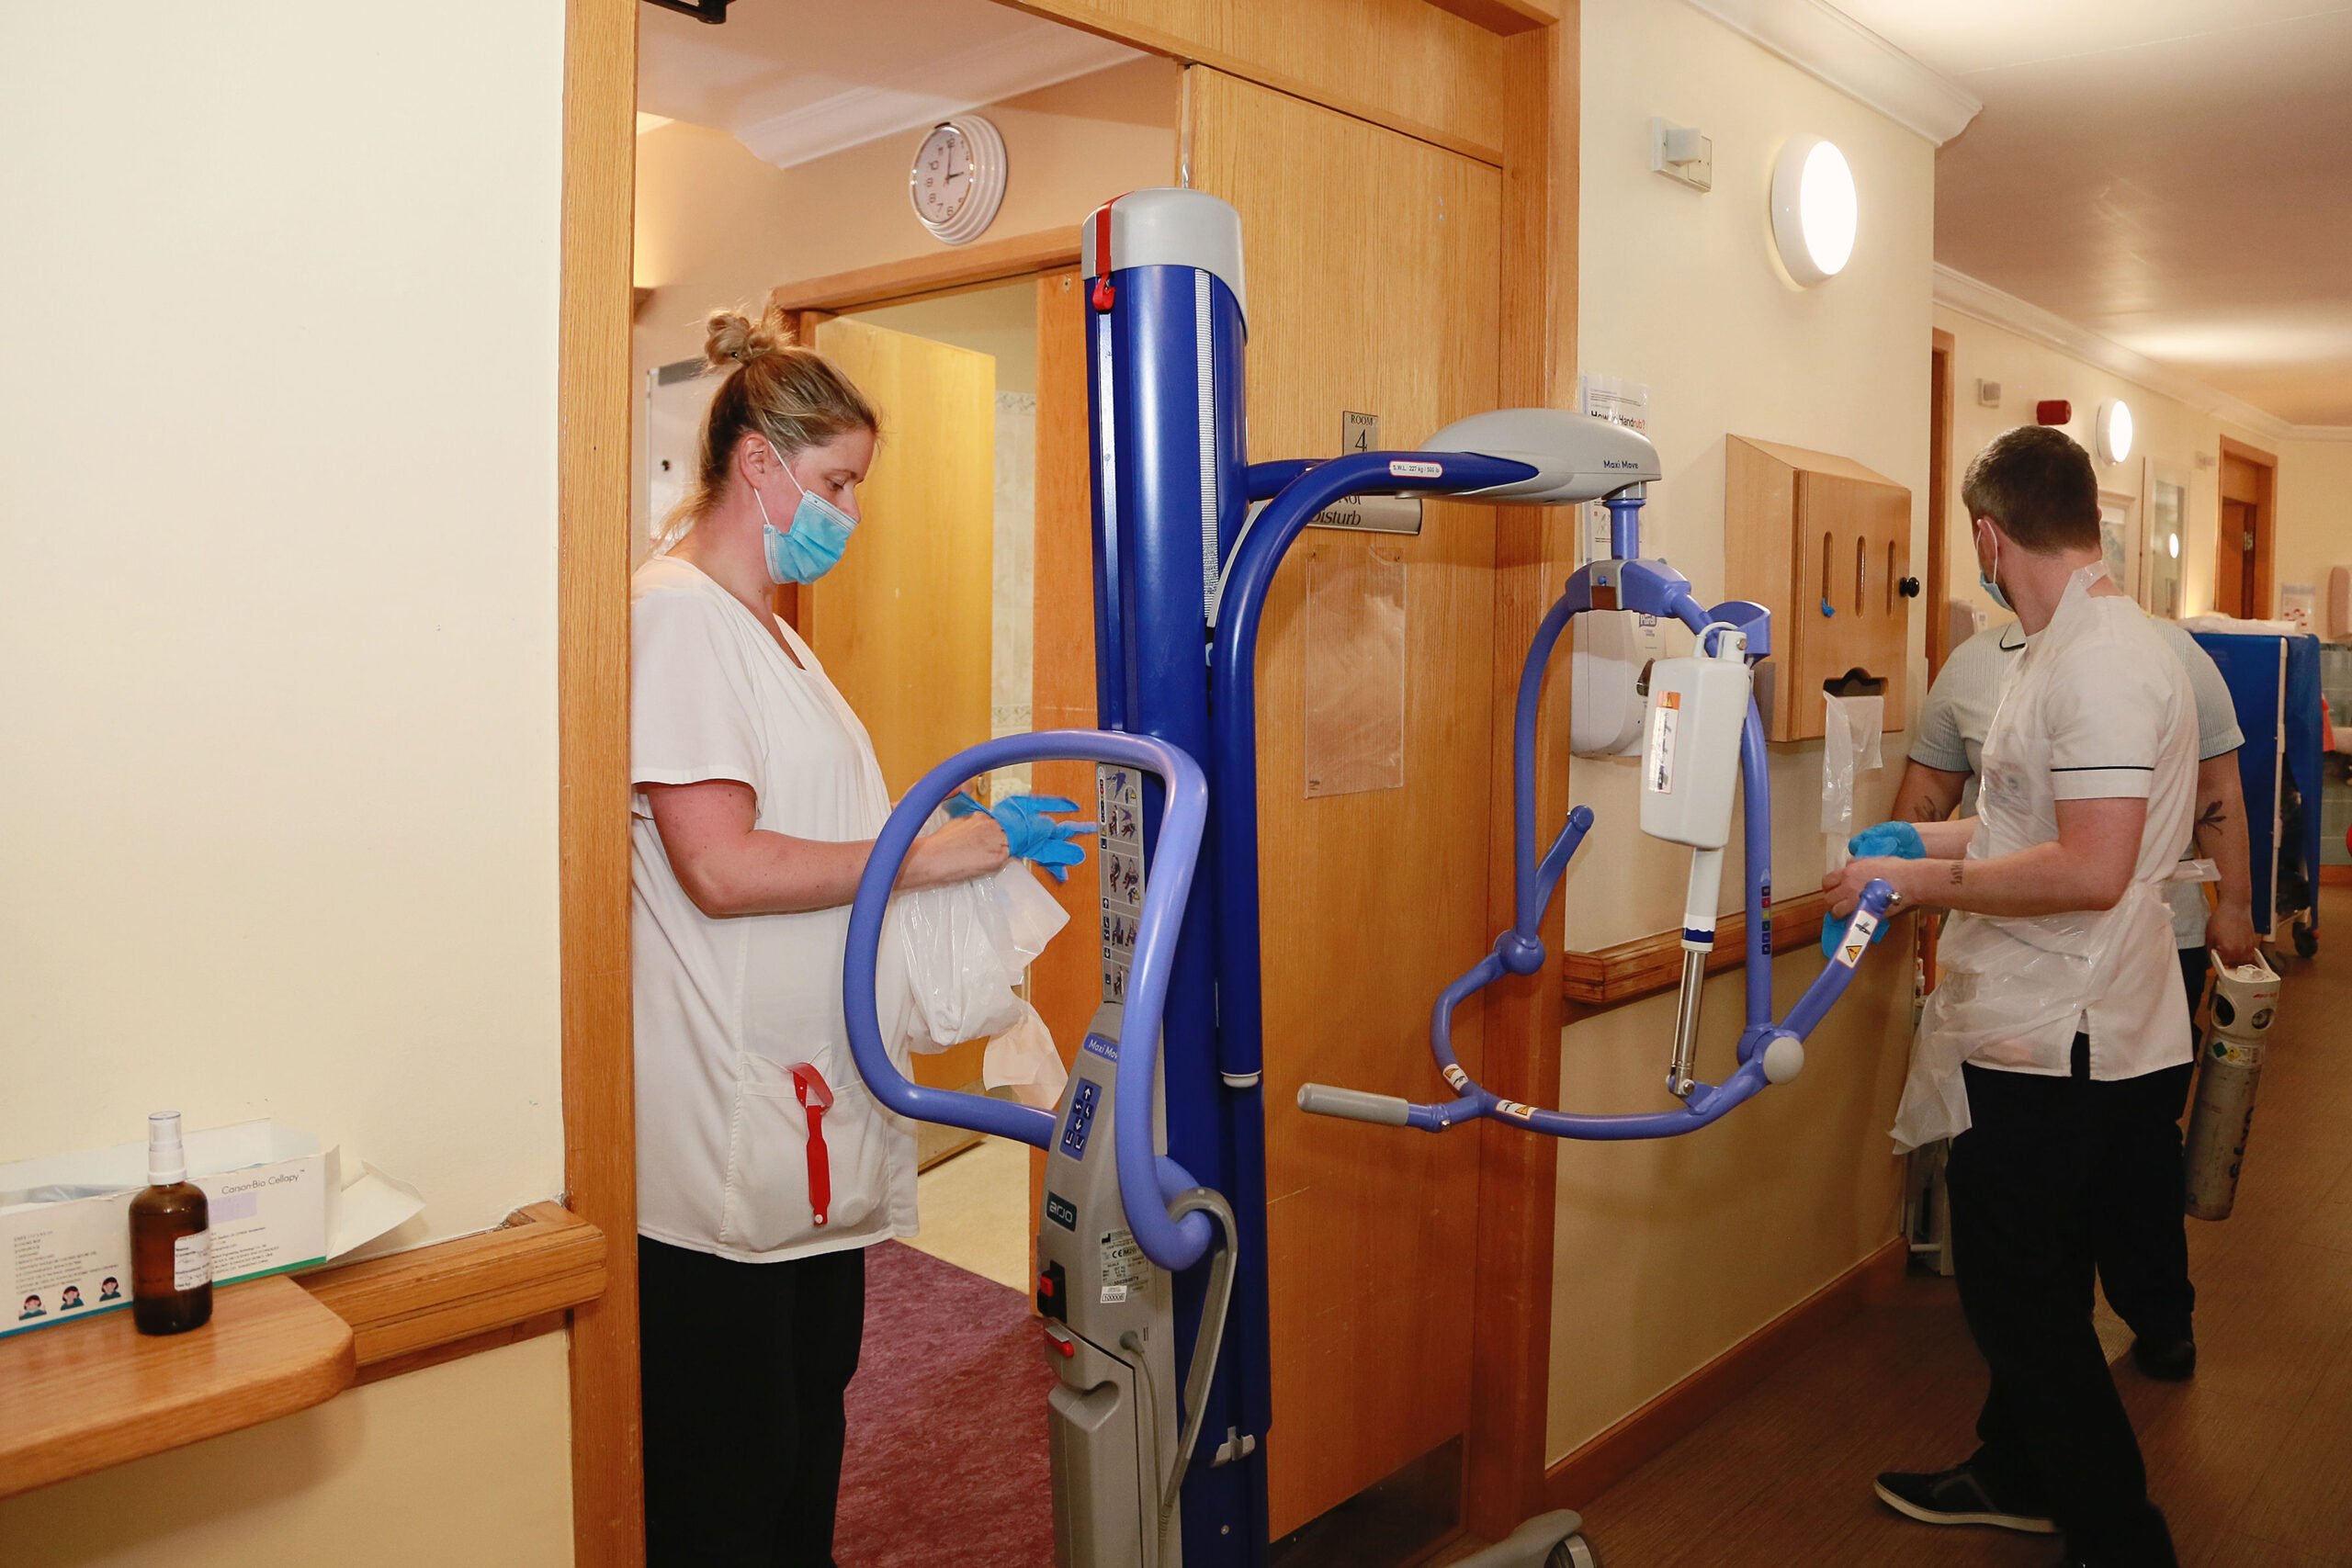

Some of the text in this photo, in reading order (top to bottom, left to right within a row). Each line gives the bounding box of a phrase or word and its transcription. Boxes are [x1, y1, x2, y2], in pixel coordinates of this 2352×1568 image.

[929, 192, 936, 203] 8
[937, 202, 944, 213] 7
[947, 205, 954, 216] 6
[1351, 414, 1374, 426] ROOM
[1355, 429, 1368, 452] 4
[1603, 459, 1639, 469] Maxi Move
[1089, 1039, 1118, 1059] Maxi Mov
[1049, 1201, 1073, 1224] arjo
